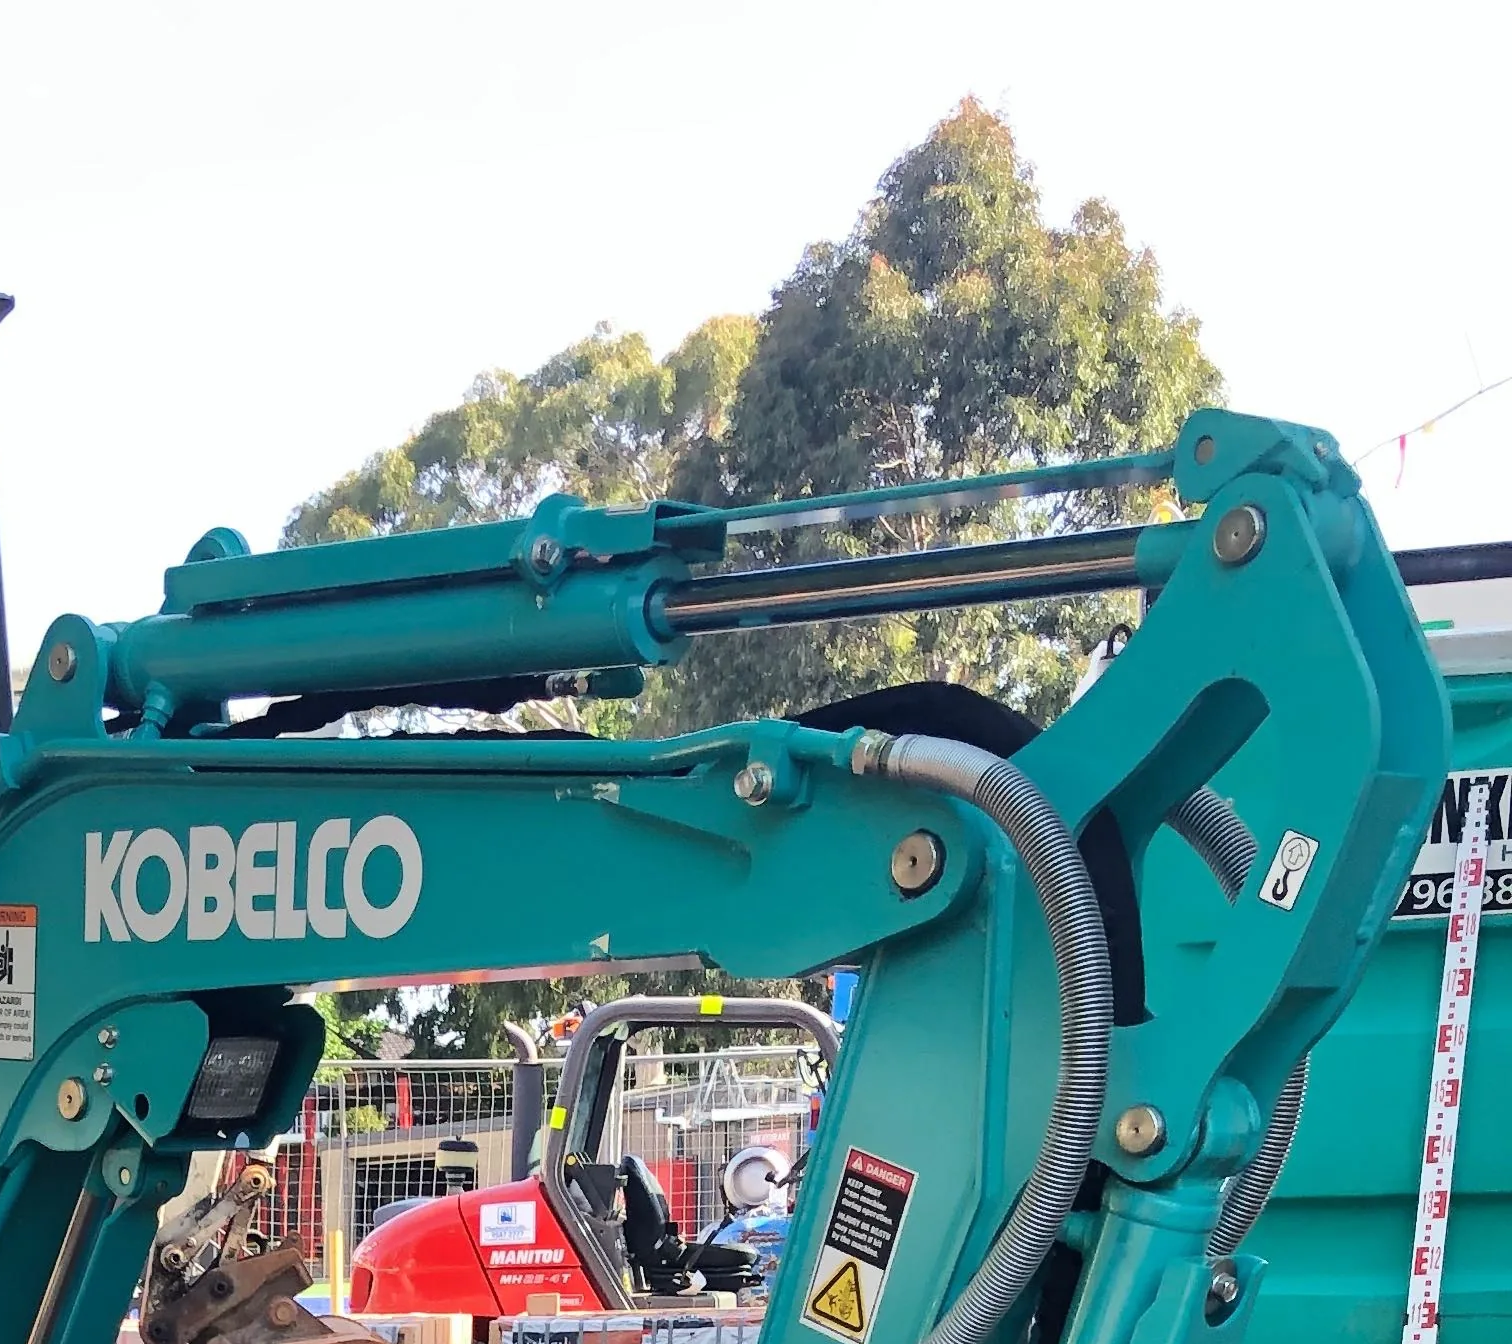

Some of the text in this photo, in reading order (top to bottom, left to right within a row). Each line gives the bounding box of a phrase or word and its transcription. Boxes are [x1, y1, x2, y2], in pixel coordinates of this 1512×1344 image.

[84, 815, 423, 943] KOBELCO
[866, 1164, 907, 1188] DANGER
[489, 1248, 565, 1265] MANITOU
